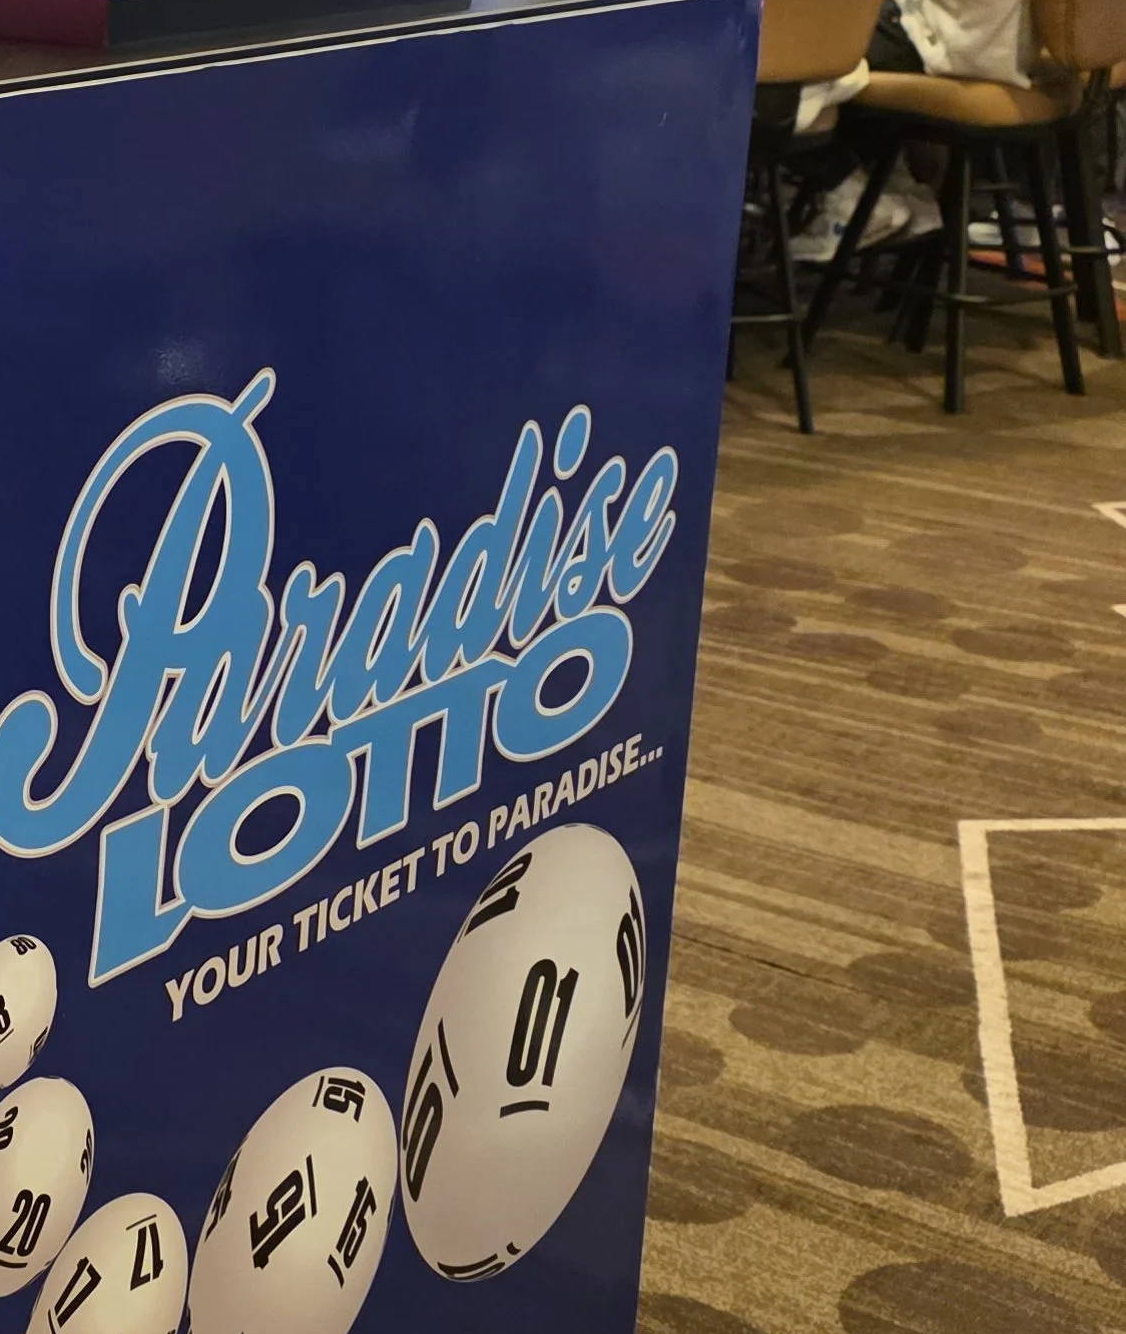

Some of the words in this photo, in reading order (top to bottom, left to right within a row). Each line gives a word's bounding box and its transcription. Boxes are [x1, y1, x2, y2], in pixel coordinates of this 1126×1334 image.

[88, 606, 634, 987] LOTTO
[165, 923, 282, 1022] YOUR
[293, 847, 427, 952] TICKET
[432, 822, 480, 878] TO
[506, 958, 579, 1087] 01
[323, 1077, 366, 1123] 15
[249, 1169, 305, 1270] 15
[336, 1176, 377, 1269] 15
